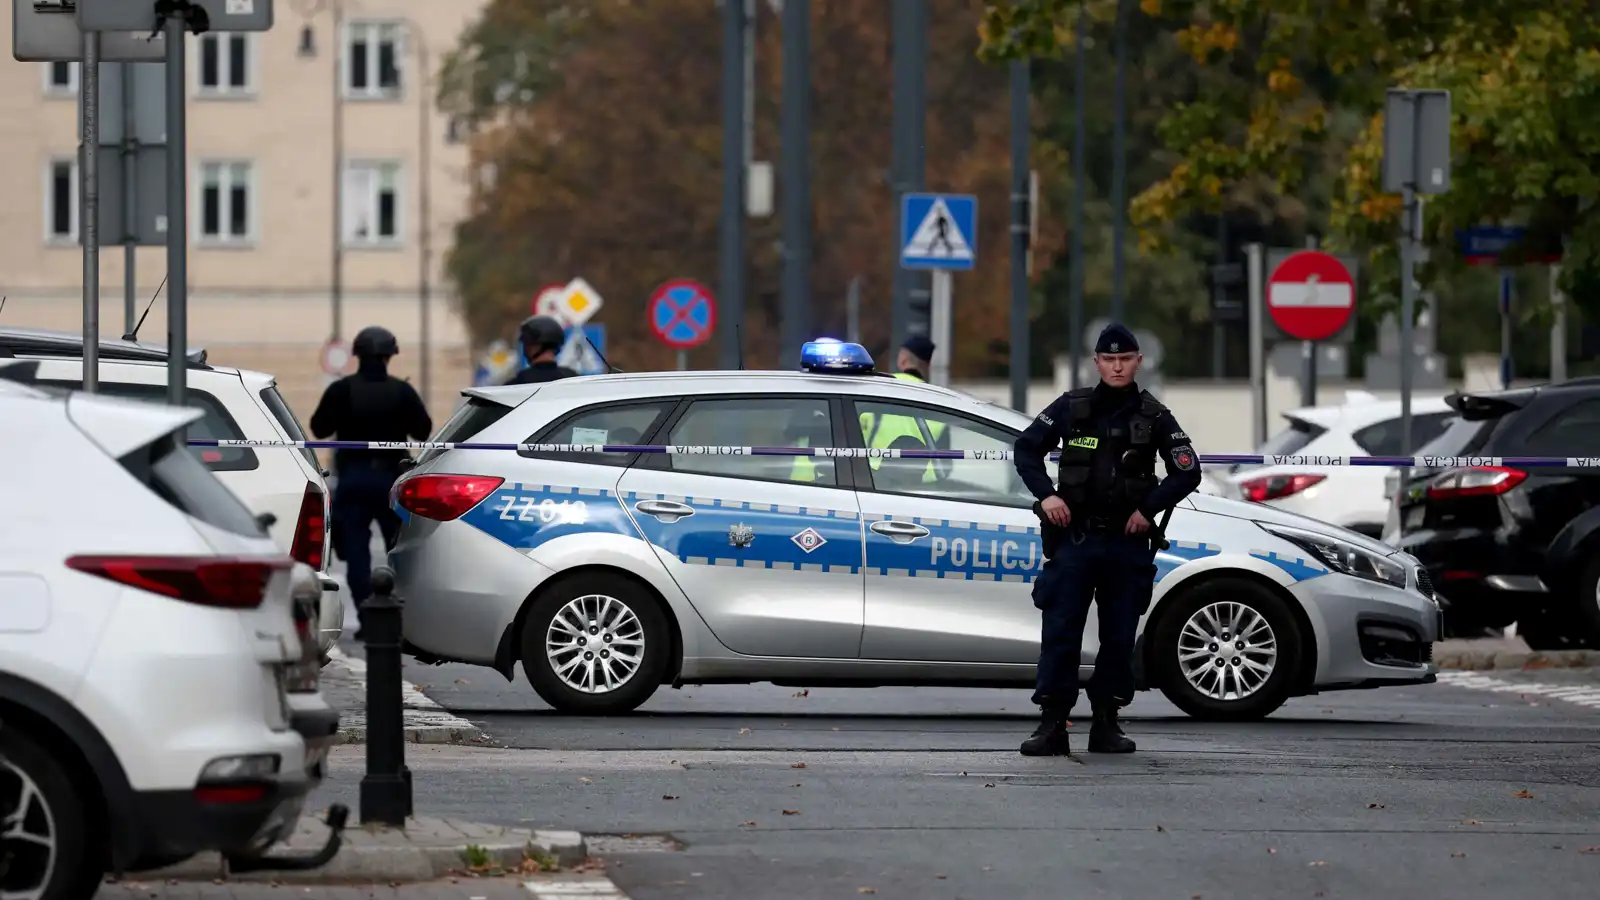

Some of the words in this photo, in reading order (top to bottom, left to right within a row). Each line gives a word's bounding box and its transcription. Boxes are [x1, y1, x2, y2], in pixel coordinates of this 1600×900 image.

[526, 444, 595, 453] POLICJA
[675, 446, 743, 455] POLICJA
[824, 448, 892, 458] POLICJA
[973, 450, 1008, 461] ICJA
[1272, 455, 1342, 466] POLICJA
[1423, 457, 1493, 467] POLICJA
